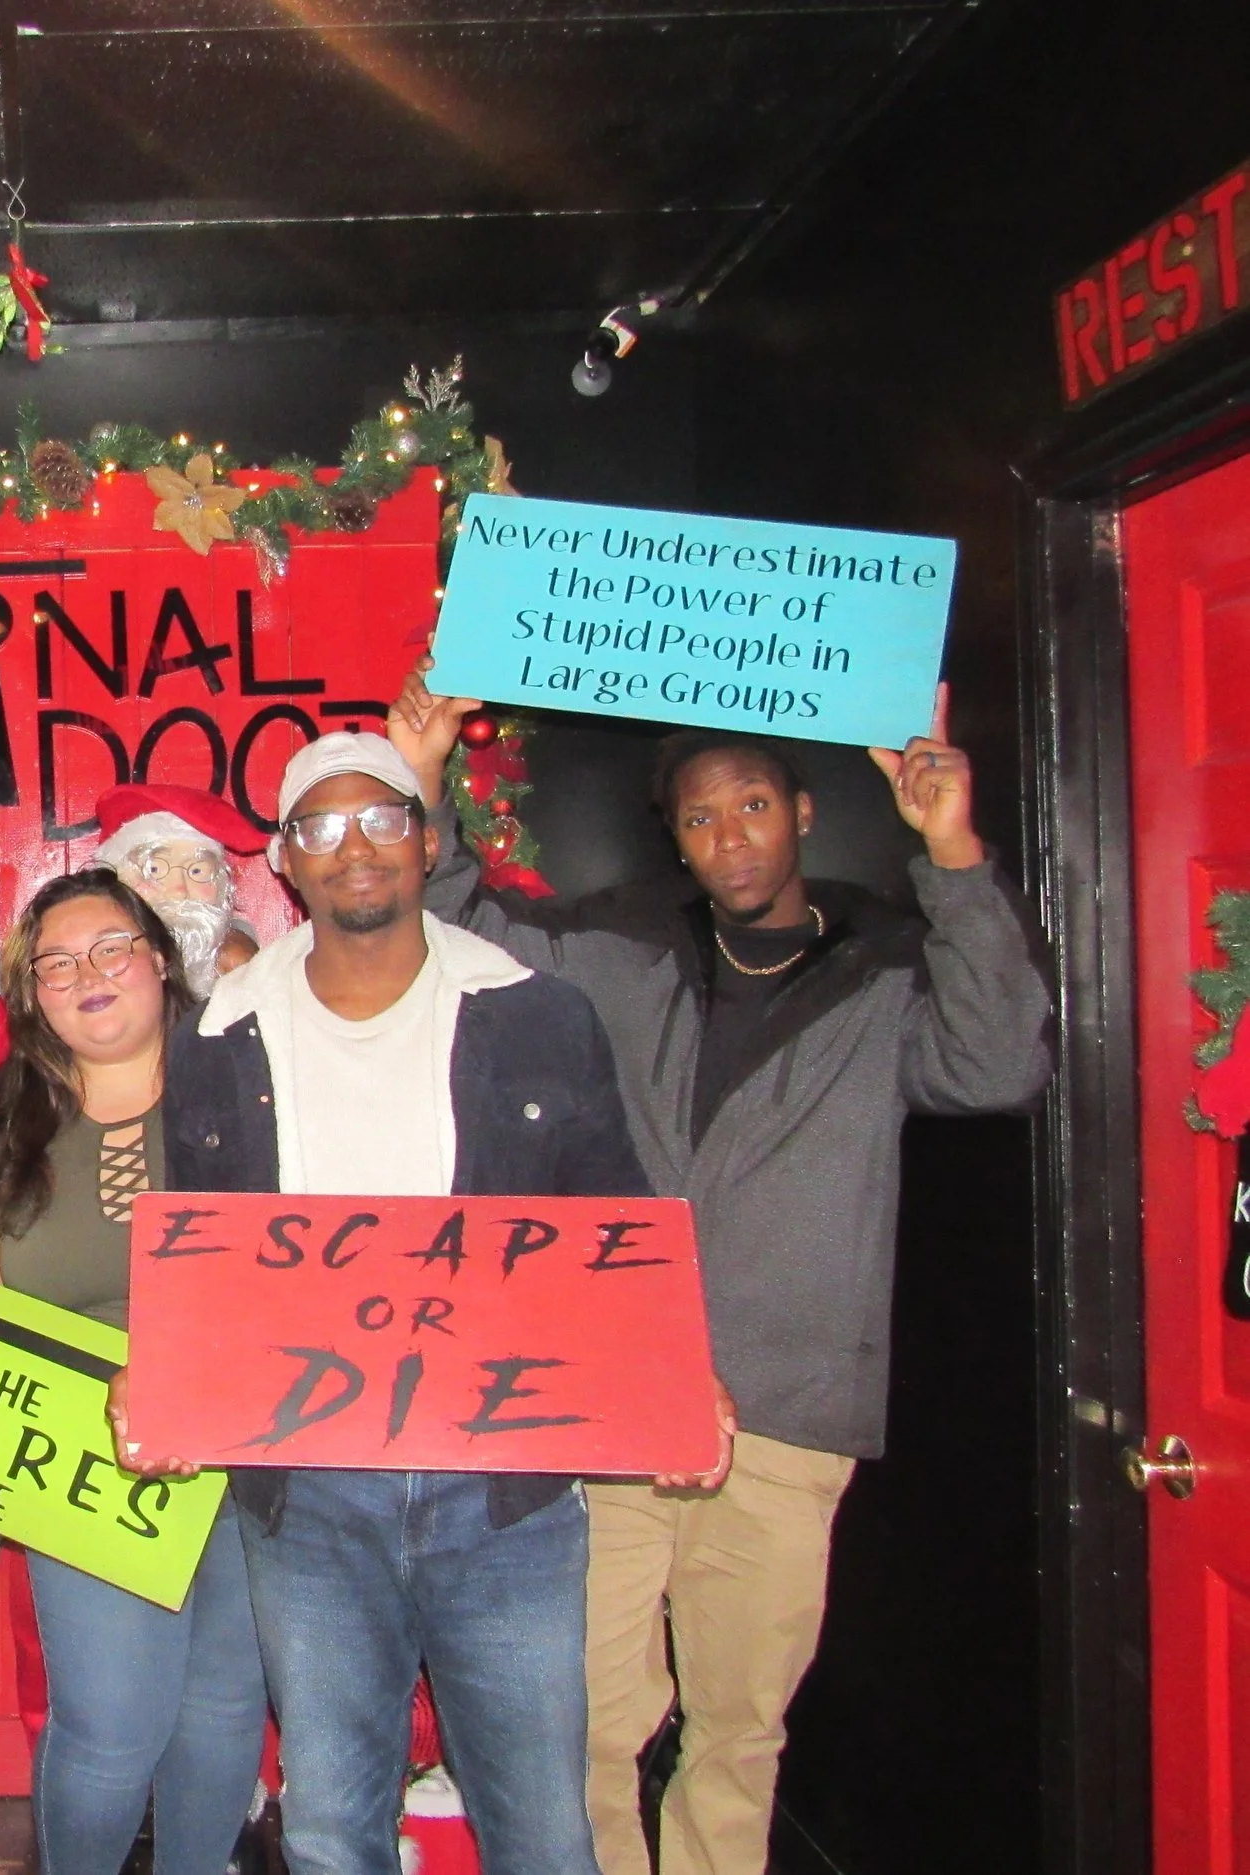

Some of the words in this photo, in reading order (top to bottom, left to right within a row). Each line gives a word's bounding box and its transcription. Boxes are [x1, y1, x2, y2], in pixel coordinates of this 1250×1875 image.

[1058, 172, 1247, 401] REST
[468, 514, 593, 557] Never
[602, 528, 937, 588] Underestimate
[547, 566, 616, 601] the
[623, 574, 773, 618] Power
[781, 591, 834, 624] of
[512, 609, 653, 656] Stupid
[657, 623, 802, 671] People
[810, 639, 852, 675] in
[519, 655, 649, 705] Large
[659, 671, 820, 724] Groups
[38, 701, 390, 842] DOO
[148, 1207, 676, 1281] ESCAPE
[355, 1295, 456, 1337] OR
[220, 1344, 596, 1453] DIE
